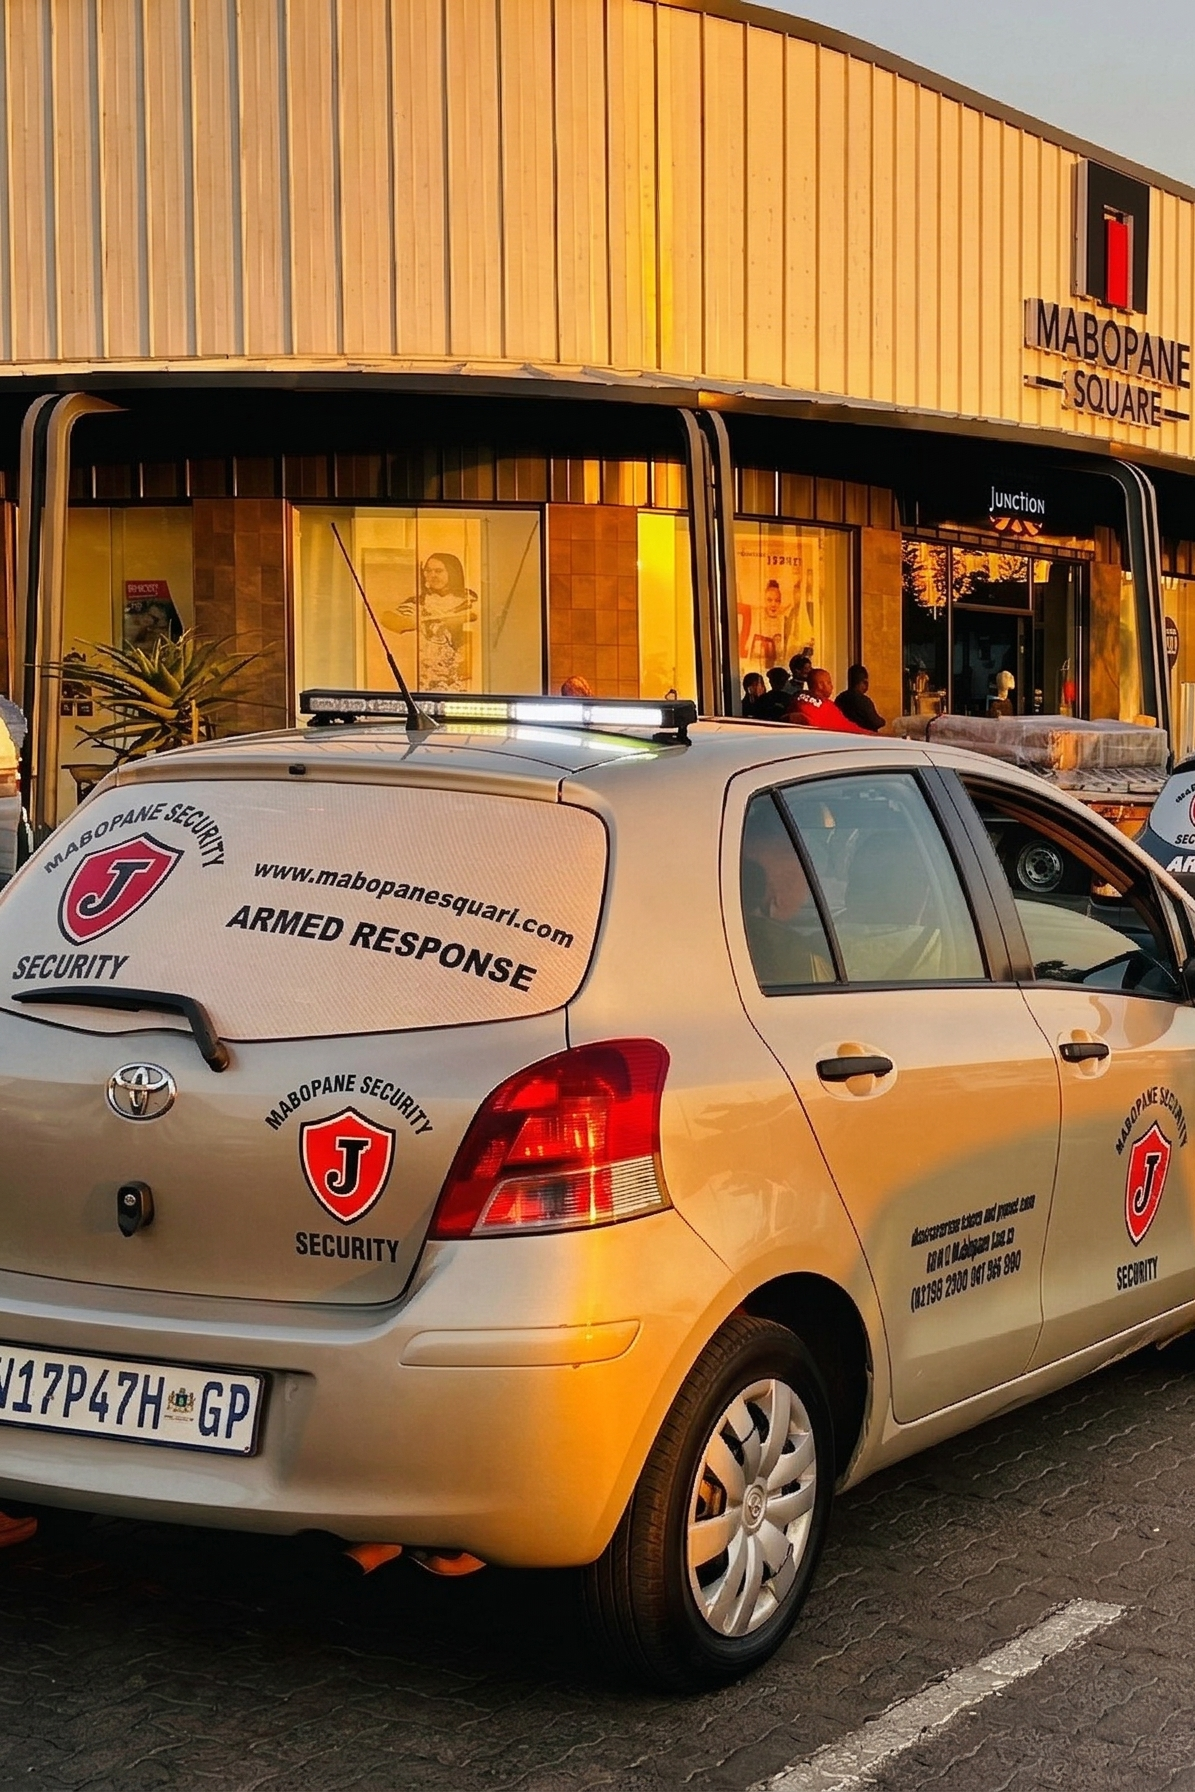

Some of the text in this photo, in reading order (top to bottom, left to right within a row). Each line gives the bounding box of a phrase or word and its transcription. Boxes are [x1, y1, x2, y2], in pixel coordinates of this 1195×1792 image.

[1036, 298, 1190, 389] MABOPANE
[1073, 370, 1162, 427] SQUARE
[44, 803, 225, 874] MABOPANE SECURITY
[78, 860, 152, 917] J
[12, 954, 130, 980] SECURITY
[226, 905, 538, 992] ARMED RESPONSE
[264, 1074, 433, 1135] MABOPANE SECURITY
[326, 1138, 370, 1196] J
[1134, 1153, 1160, 1214] J
[295, 1231, 400, 1263] SECURITY
[1116, 1255, 1159, 1291] SECURITY
[198, 1381, 250, 1439] GP
